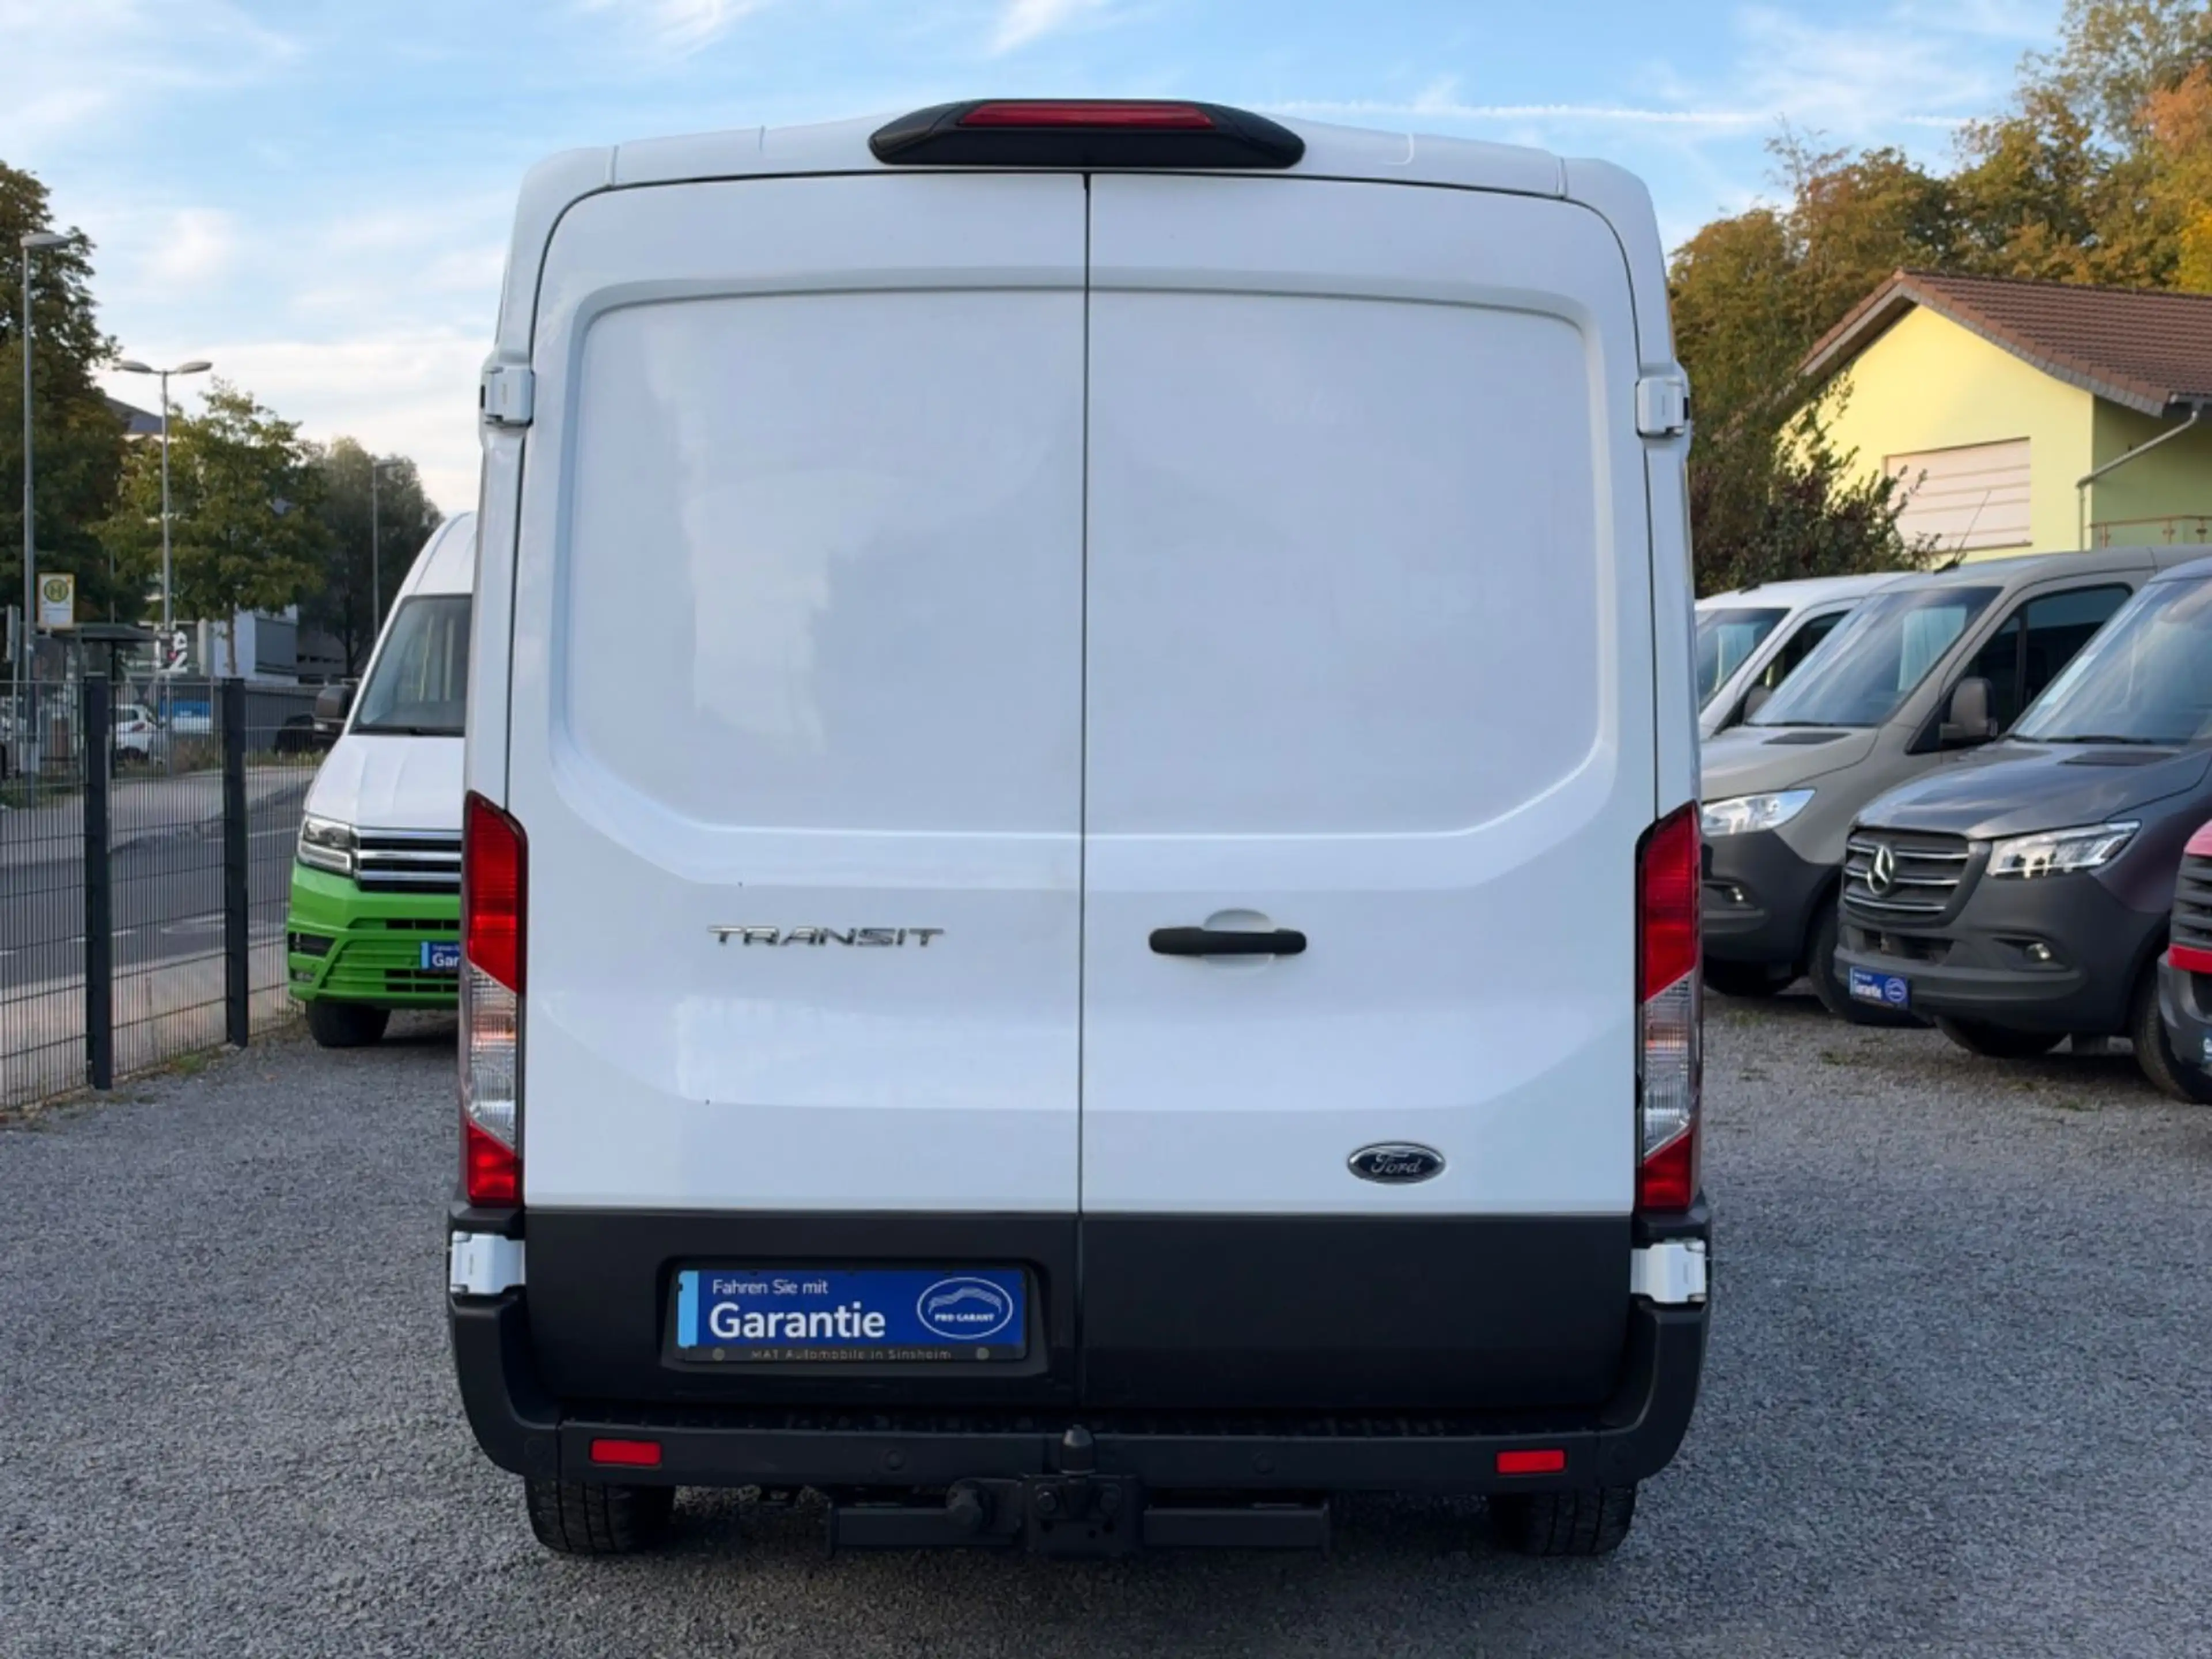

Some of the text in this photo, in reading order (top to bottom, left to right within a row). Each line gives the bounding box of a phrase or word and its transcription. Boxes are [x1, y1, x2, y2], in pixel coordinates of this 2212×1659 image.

[709, 926, 944, 946] TRANSIT
[1372, 1153, 1423, 1174] Ford
[713, 1278, 829, 1294] Fahren Sie mit
[709, 1301, 886, 1339] Garantie
